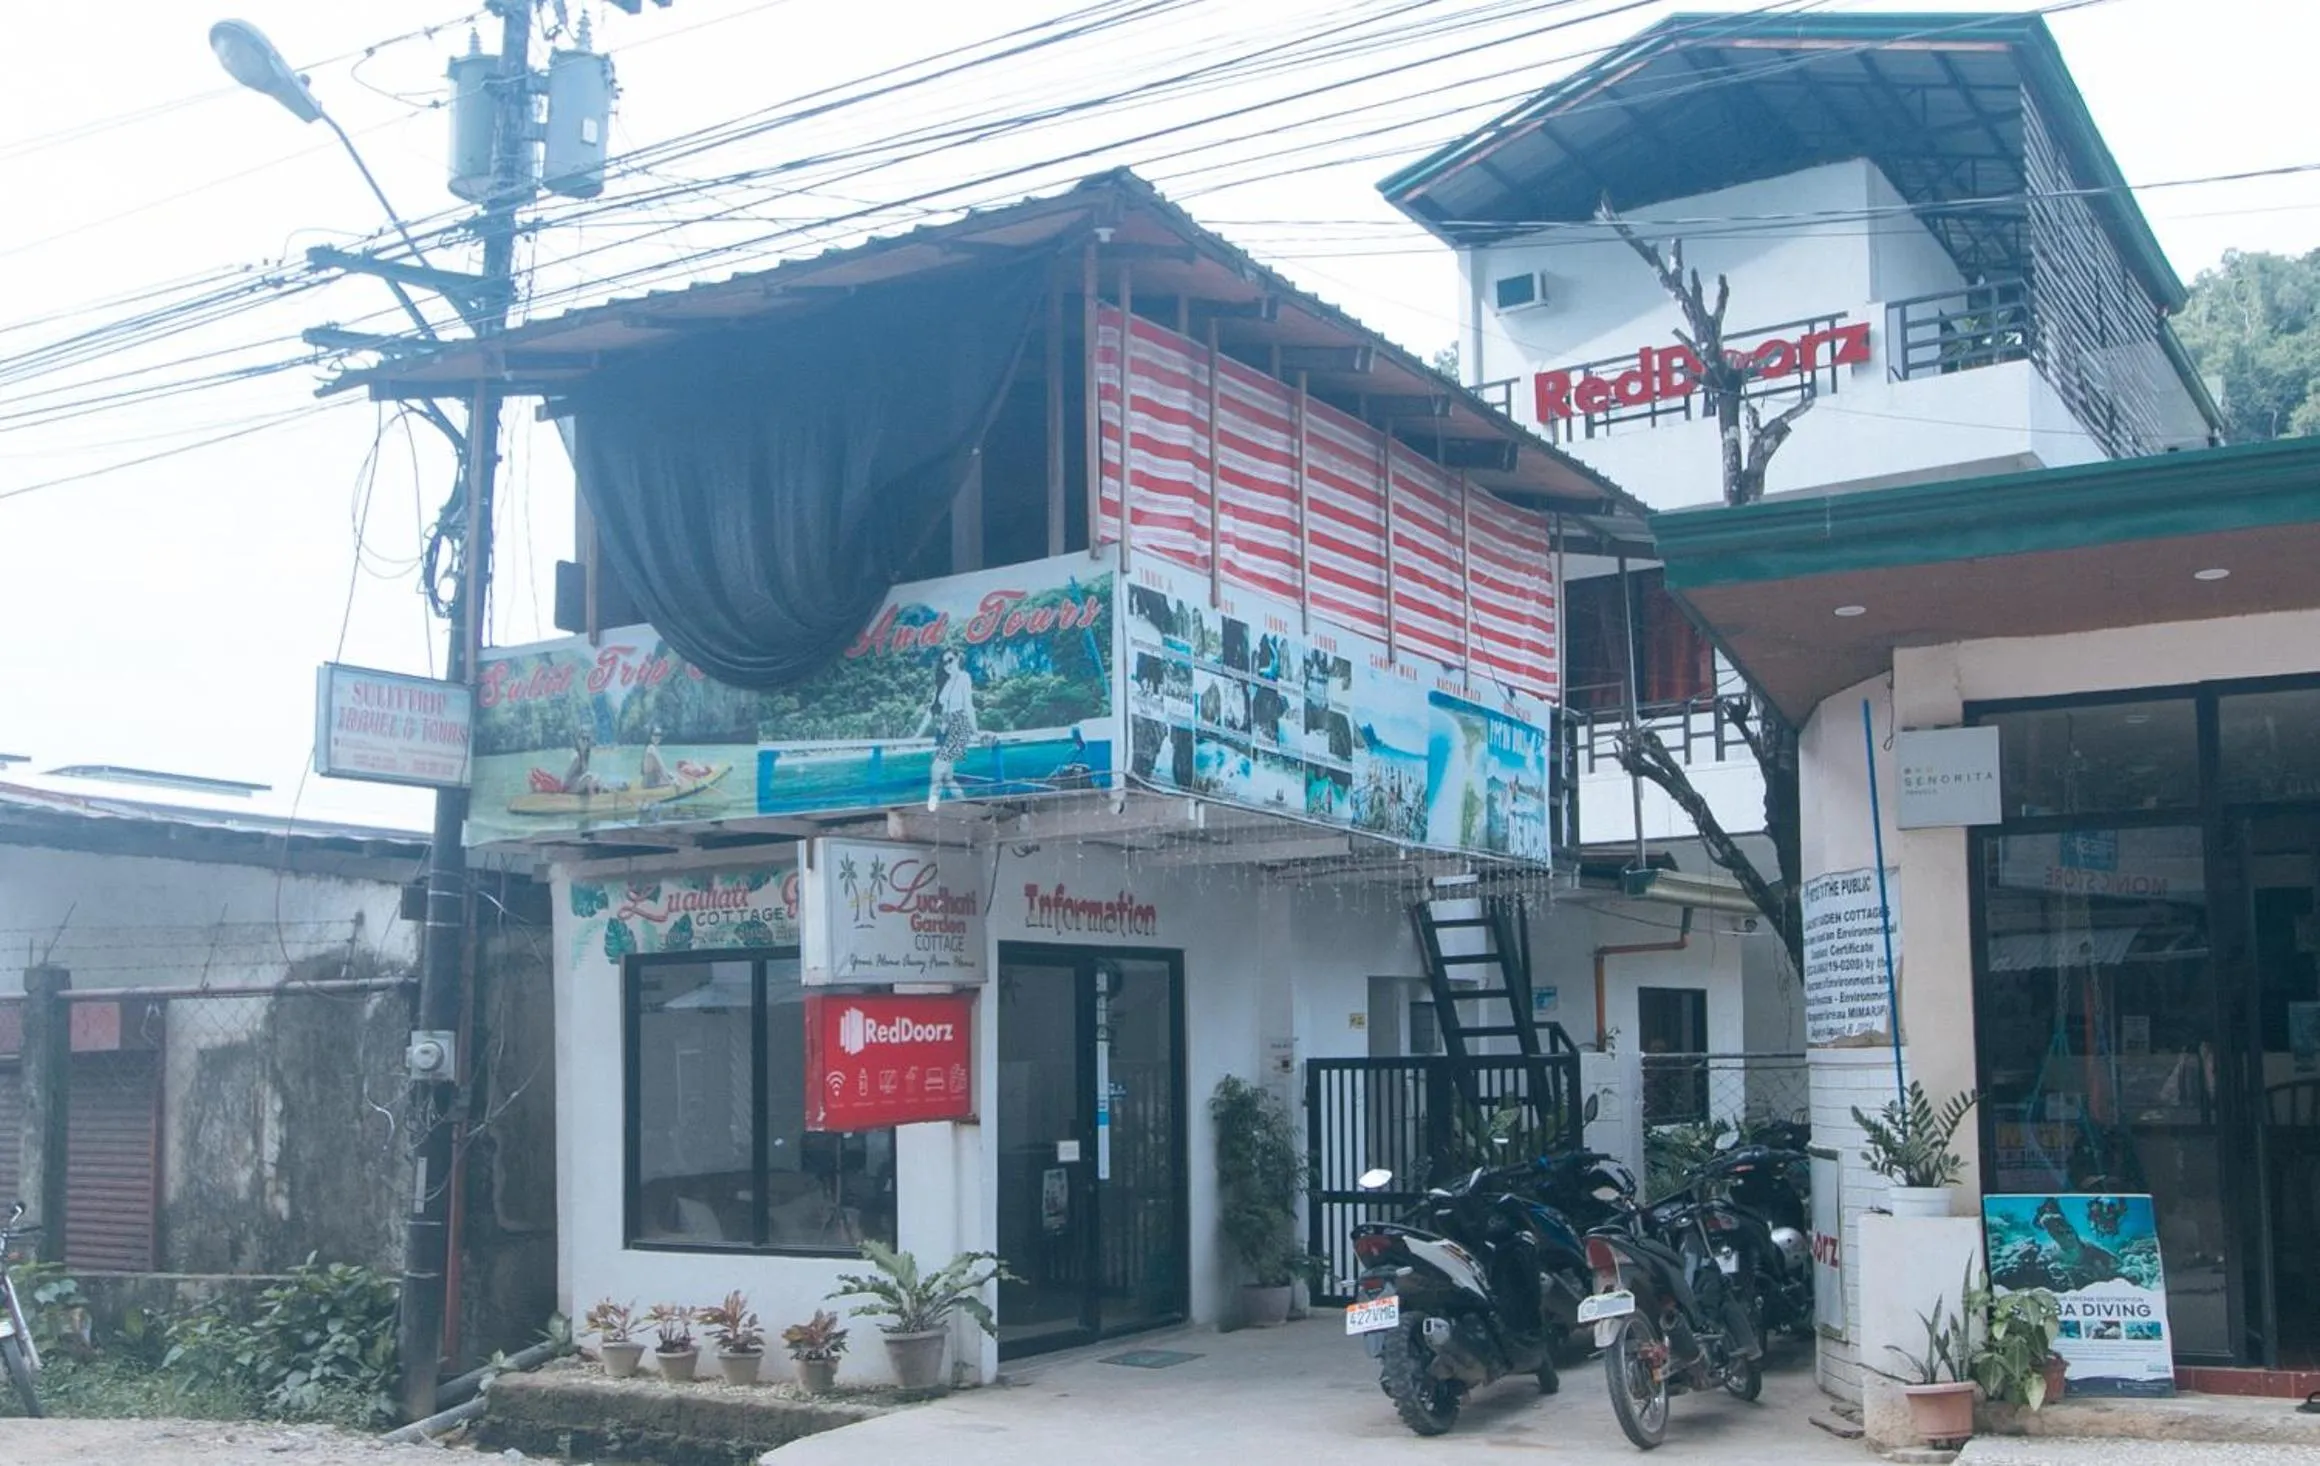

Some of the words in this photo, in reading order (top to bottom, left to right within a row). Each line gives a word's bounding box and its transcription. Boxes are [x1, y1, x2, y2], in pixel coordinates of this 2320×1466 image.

[846, 603, 949, 657] And
[966, 589, 1102, 643] Tours
[479, 660, 574, 708] Sulit
[587, 645, 670, 692] Trip
[1841, 875, 1871, 896] PUBLIC
[695, 906, 785, 927] COTTAGE
[1024, 882, 1157, 937] Information
[911, 913, 966, 934] Garden
[1837, 921, 1897, 940] Environmenal
[915, 934, 965, 952] COTTAGE
[865, 1016, 953, 1044] RedDoorz
[2011, 1303, 2077, 1317] SBA
[2082, 1303, 2151, 1317] DIVING
